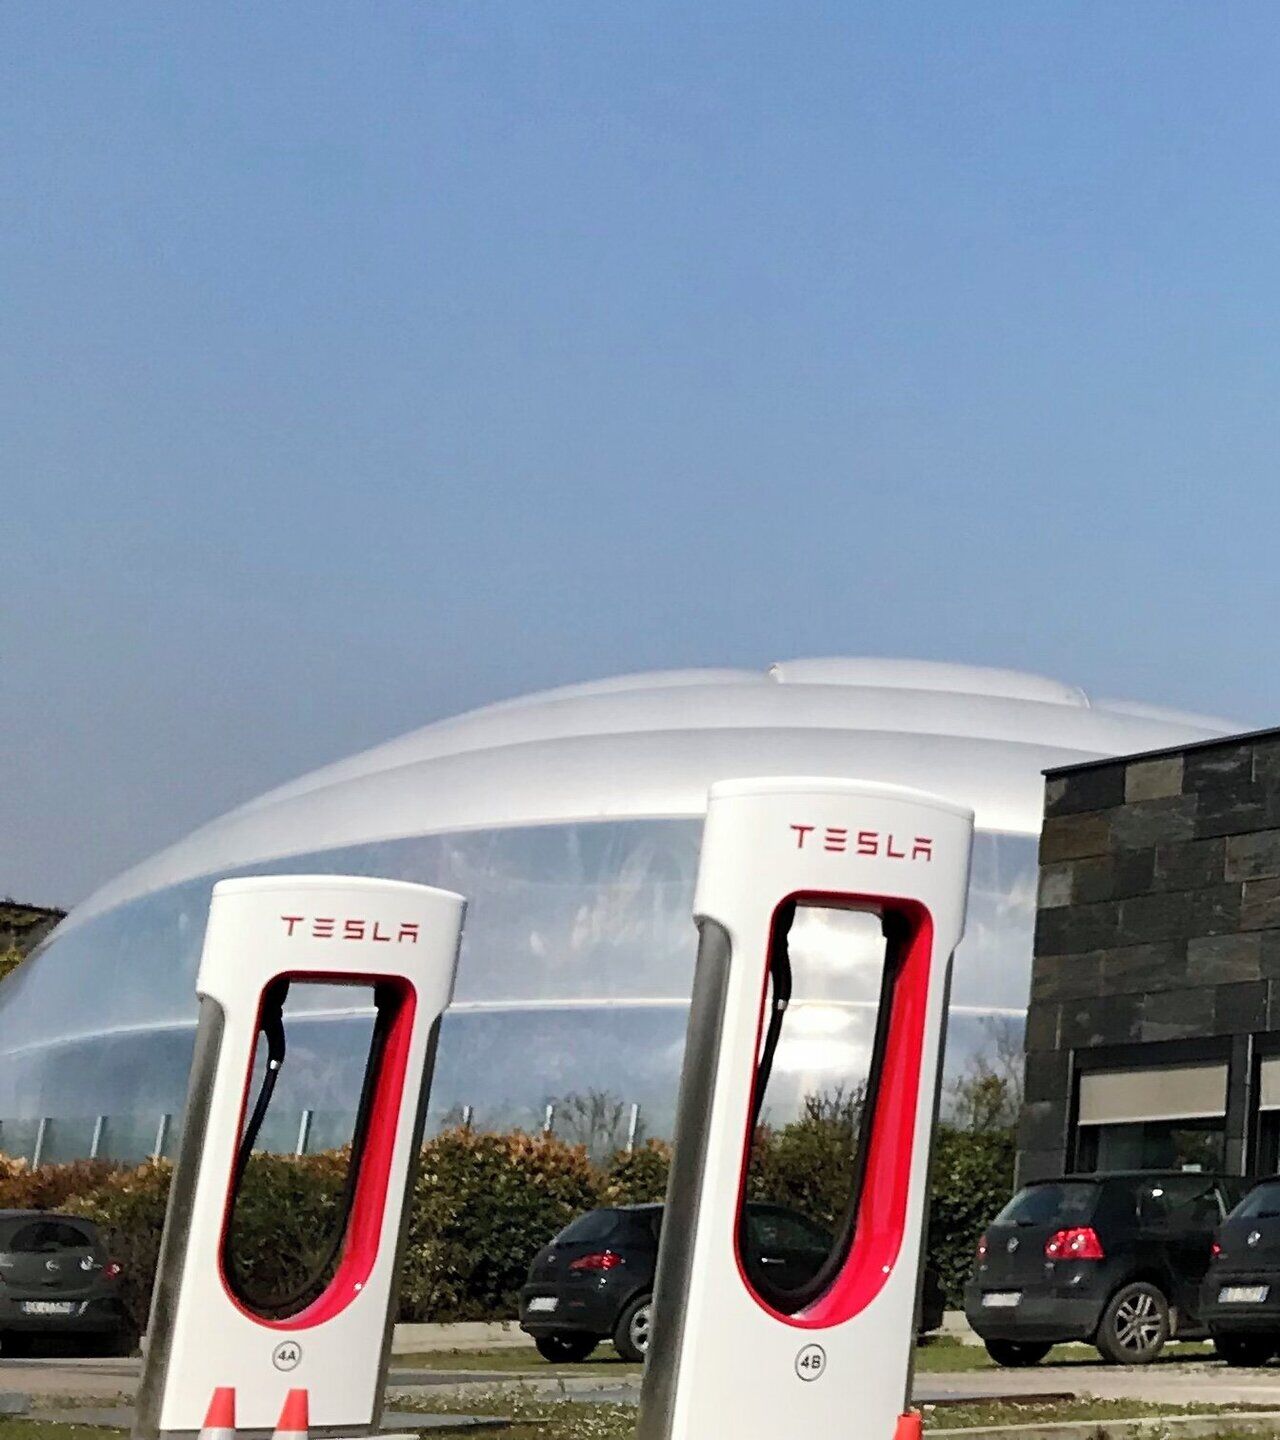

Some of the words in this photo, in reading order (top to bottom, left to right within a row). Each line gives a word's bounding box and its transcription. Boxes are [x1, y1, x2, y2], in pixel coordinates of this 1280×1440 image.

[790, 824, 932, 861] TESLA
[281, 916, 418, 943] TESLA
[278, 1350, 296, 1360] 4A
[801, 1355, 820, 1369] 4B
